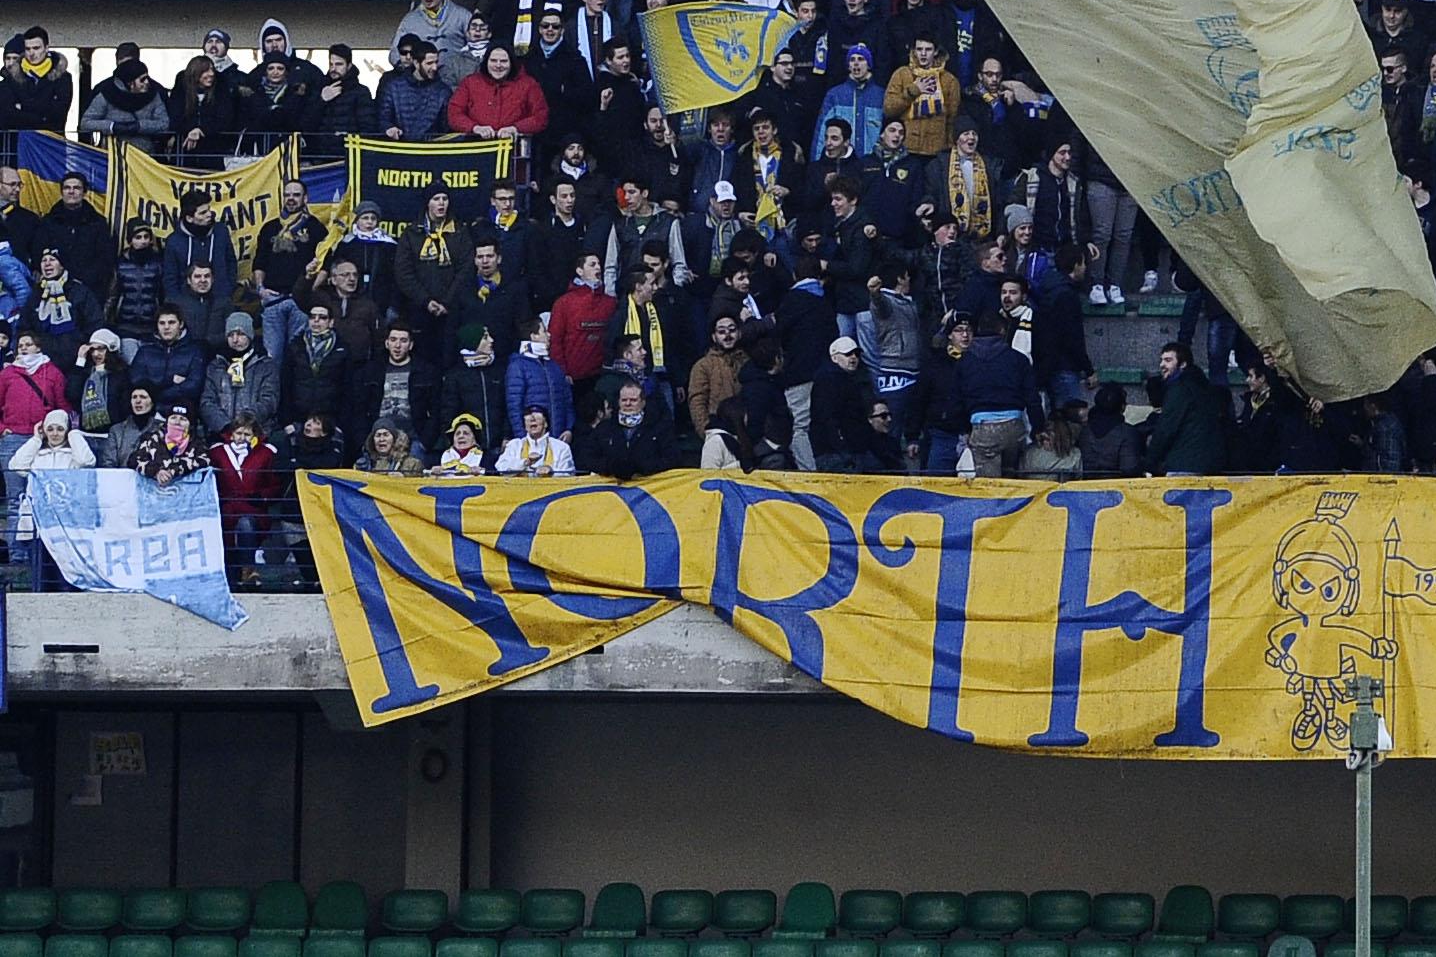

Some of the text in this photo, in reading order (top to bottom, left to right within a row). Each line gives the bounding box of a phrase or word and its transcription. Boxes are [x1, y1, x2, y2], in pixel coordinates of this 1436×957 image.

[377, 168, 479, 188] NORTH SIDE
[138, 193, 272, 231] IGNANT
[307, 472, 1232, 748] NORTH
